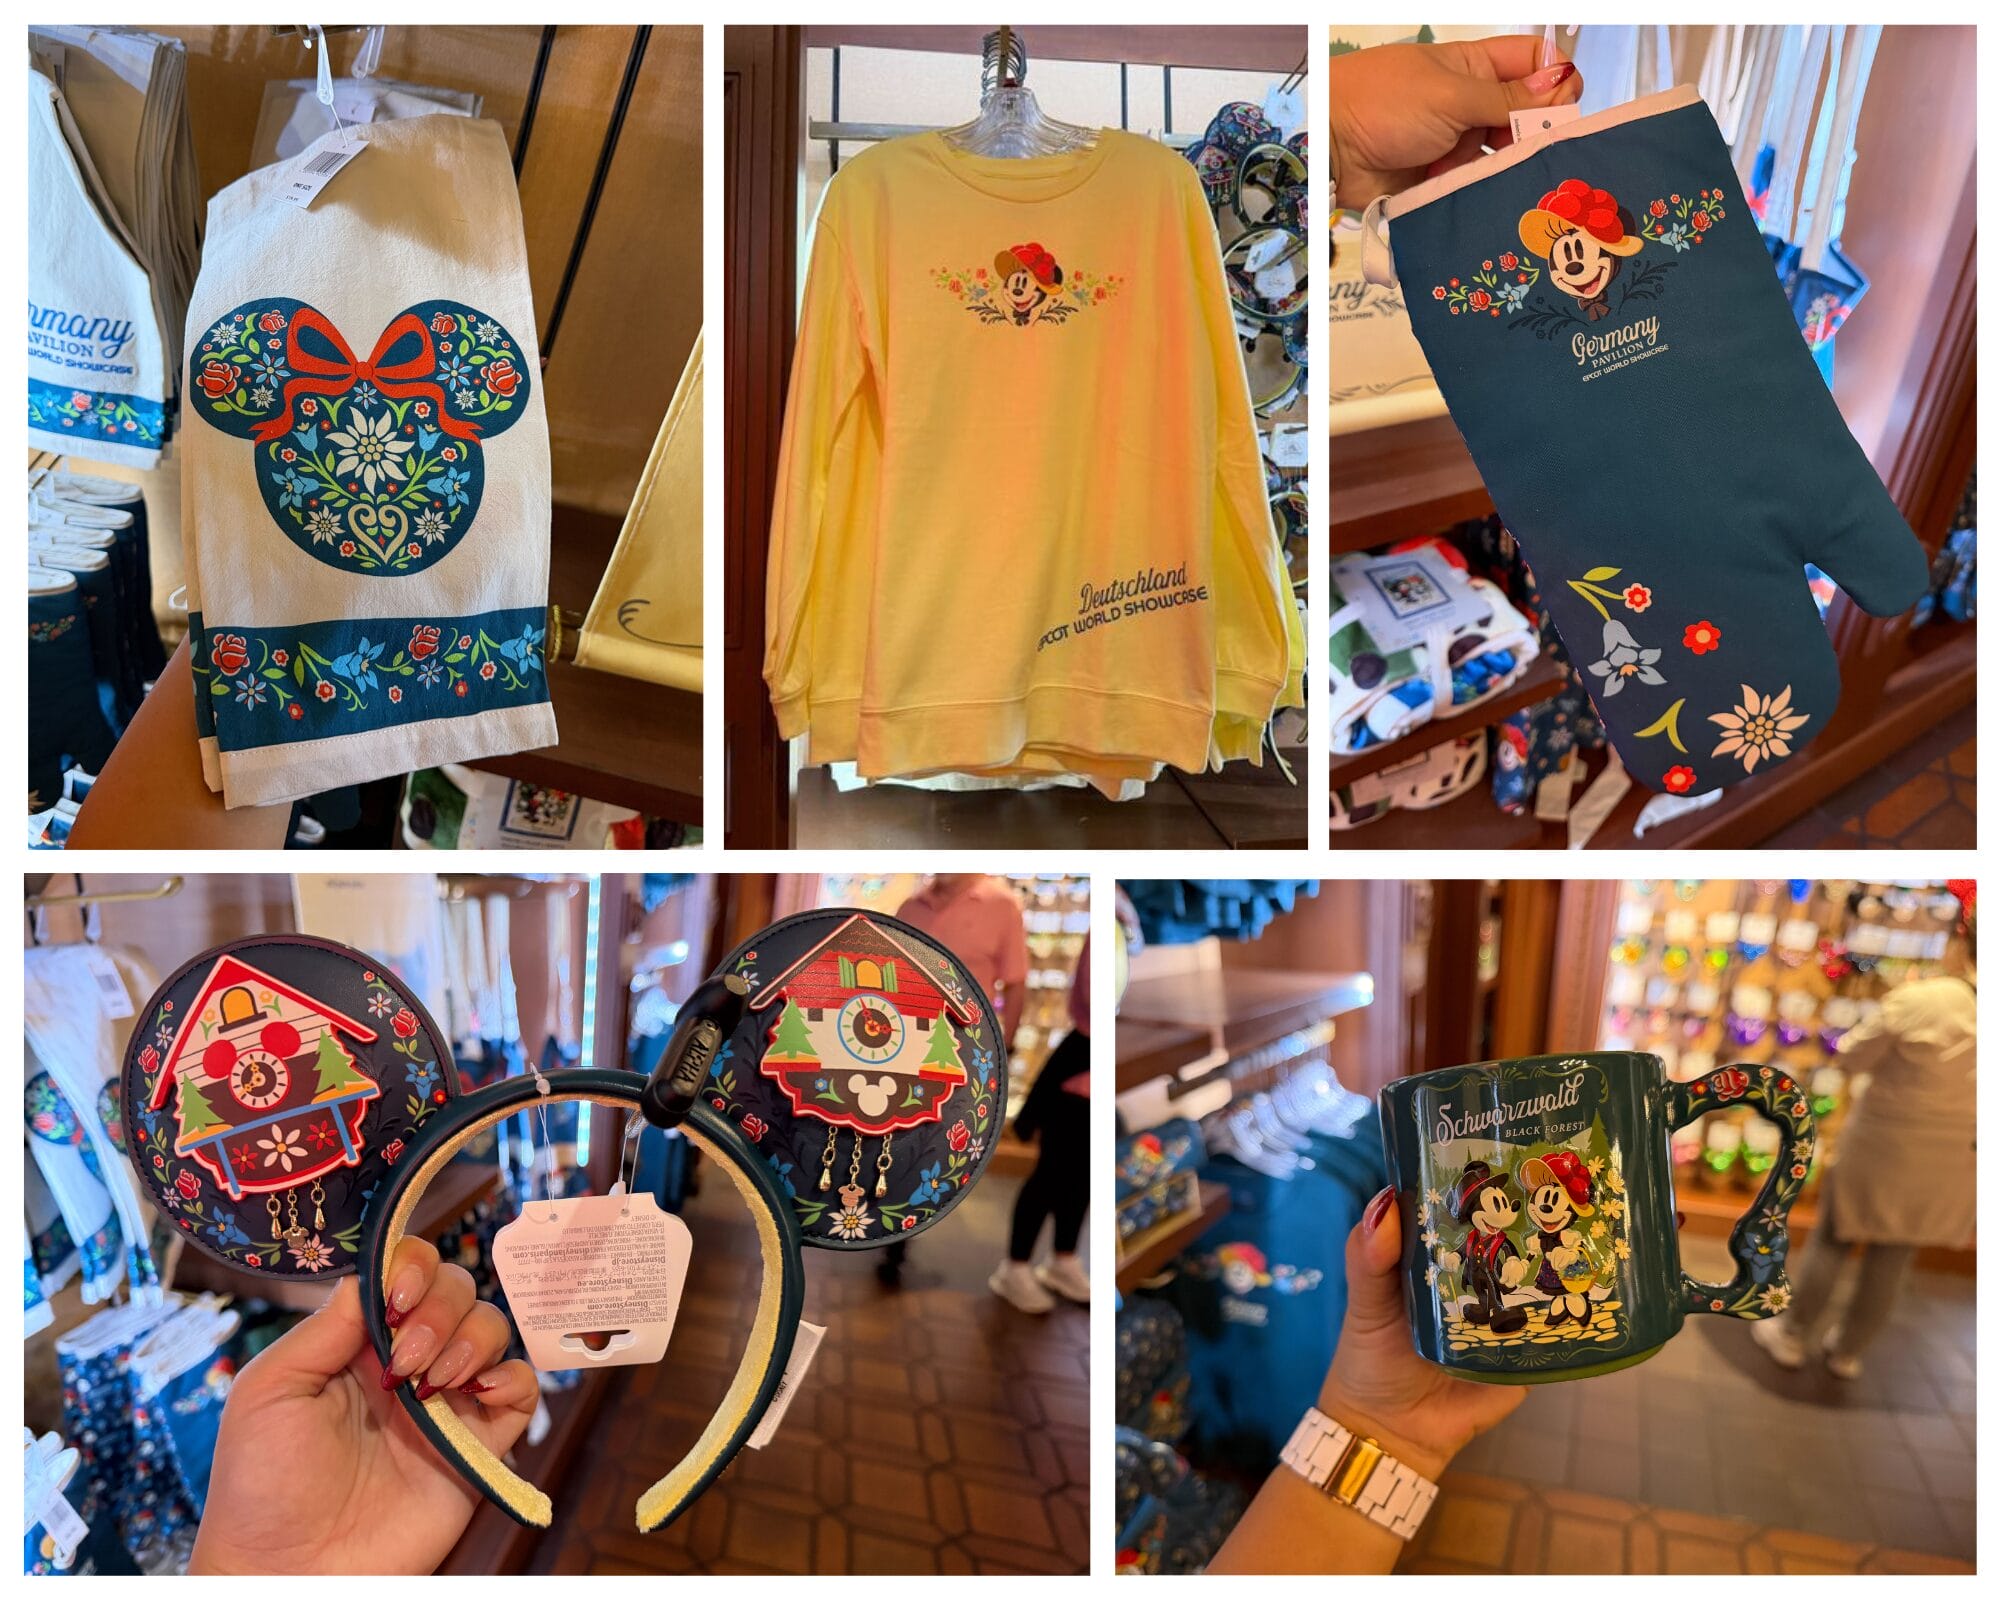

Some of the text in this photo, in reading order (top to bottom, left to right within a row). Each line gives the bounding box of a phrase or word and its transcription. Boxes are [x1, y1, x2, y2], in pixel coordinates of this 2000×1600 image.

[28, 331, 95, 358] VILION
[1571, 315, 1660, 366] Germany
[1591, 341, 1644, 368] PAVILION
[65, 358, 133, 375] SHOWCASE
[1582, 343, 1669, 382] EPCOT WORLD SHOWCASE
[1078, 560, 1187, 615] Deutschland
[1073, 606, 1122, 634] WORLD
[1123, 586, 1208, 617] SHOWCASE
[1436, 1073, 1585, 1147] Schwarzwald
[1505, 1121, 1585, 1138] BLACK FOREST
